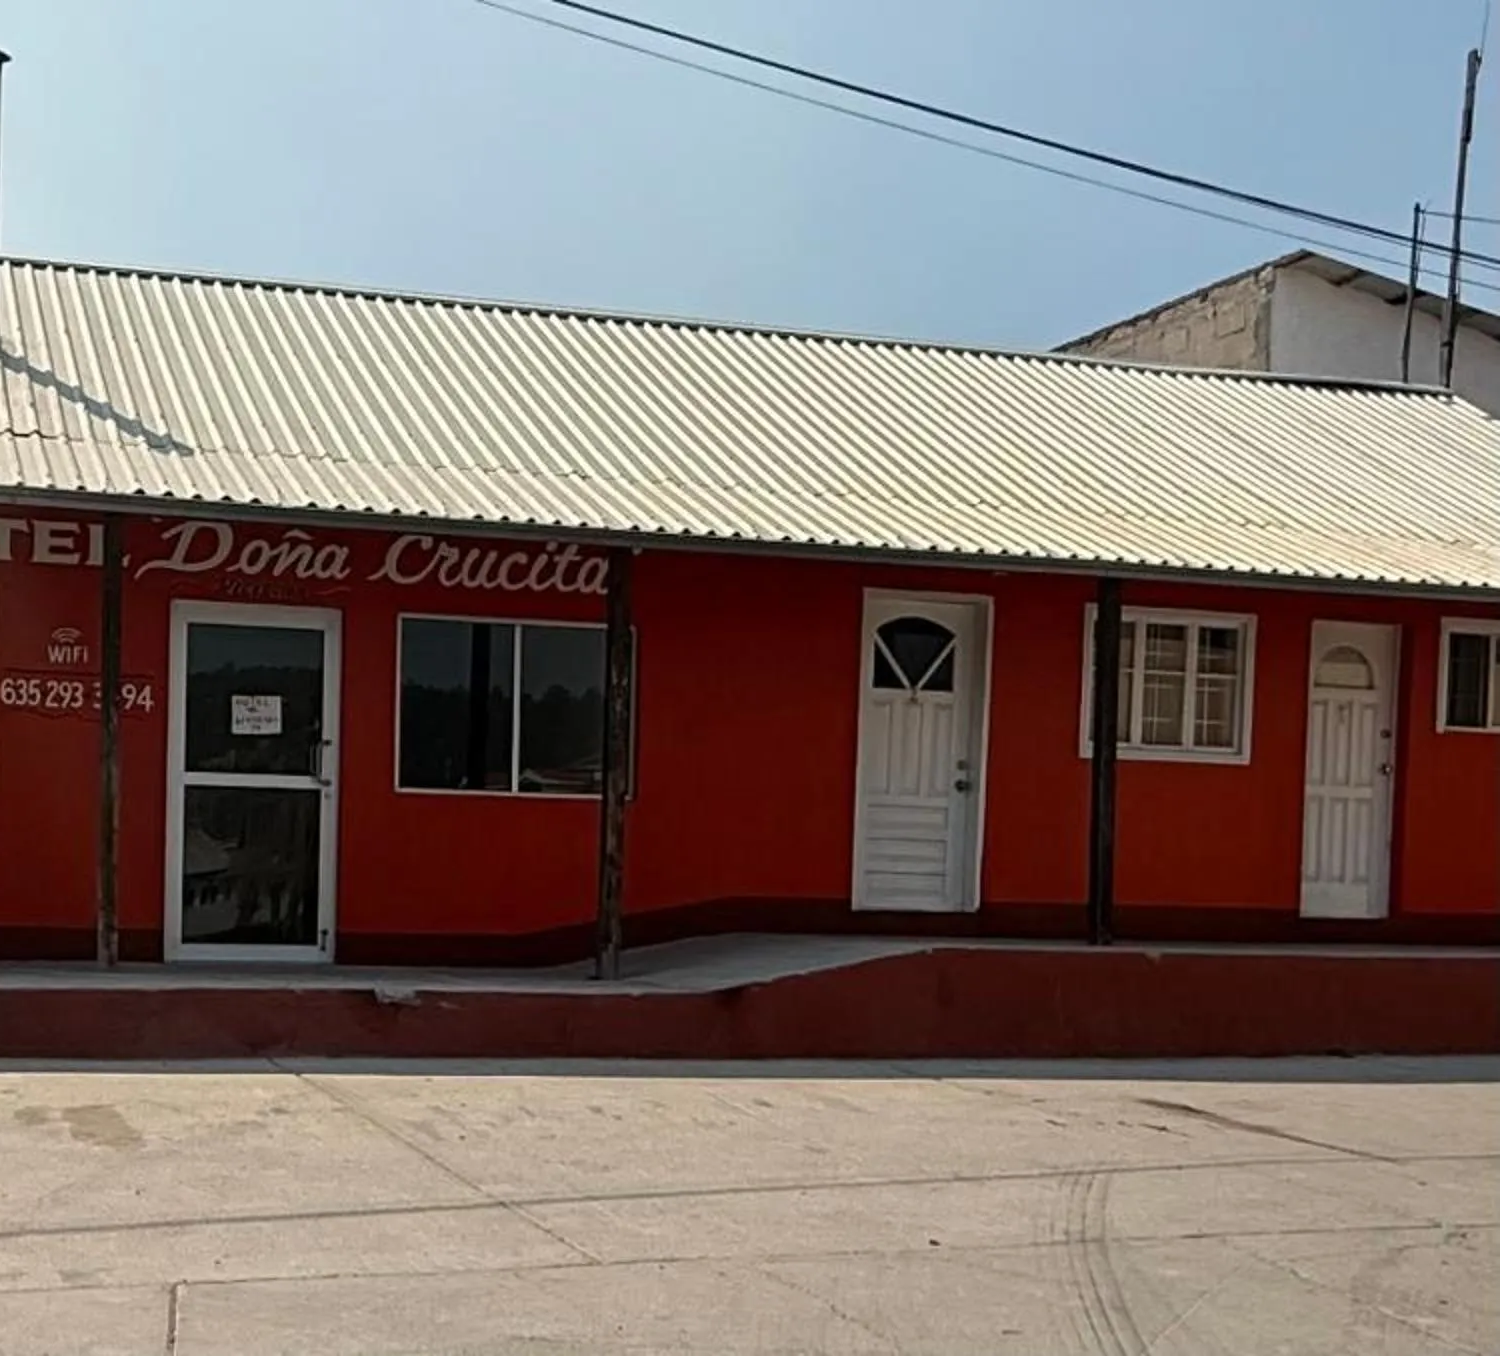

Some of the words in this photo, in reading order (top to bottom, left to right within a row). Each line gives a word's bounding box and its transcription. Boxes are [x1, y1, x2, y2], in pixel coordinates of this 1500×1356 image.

[134, 520, 350, 579] Doña
[366, 535, 609, 594] Crucita
[1, 678, 41, 705] 635
[45, 681, 84, 708] 293
[92, 682, 153, 712] 394
